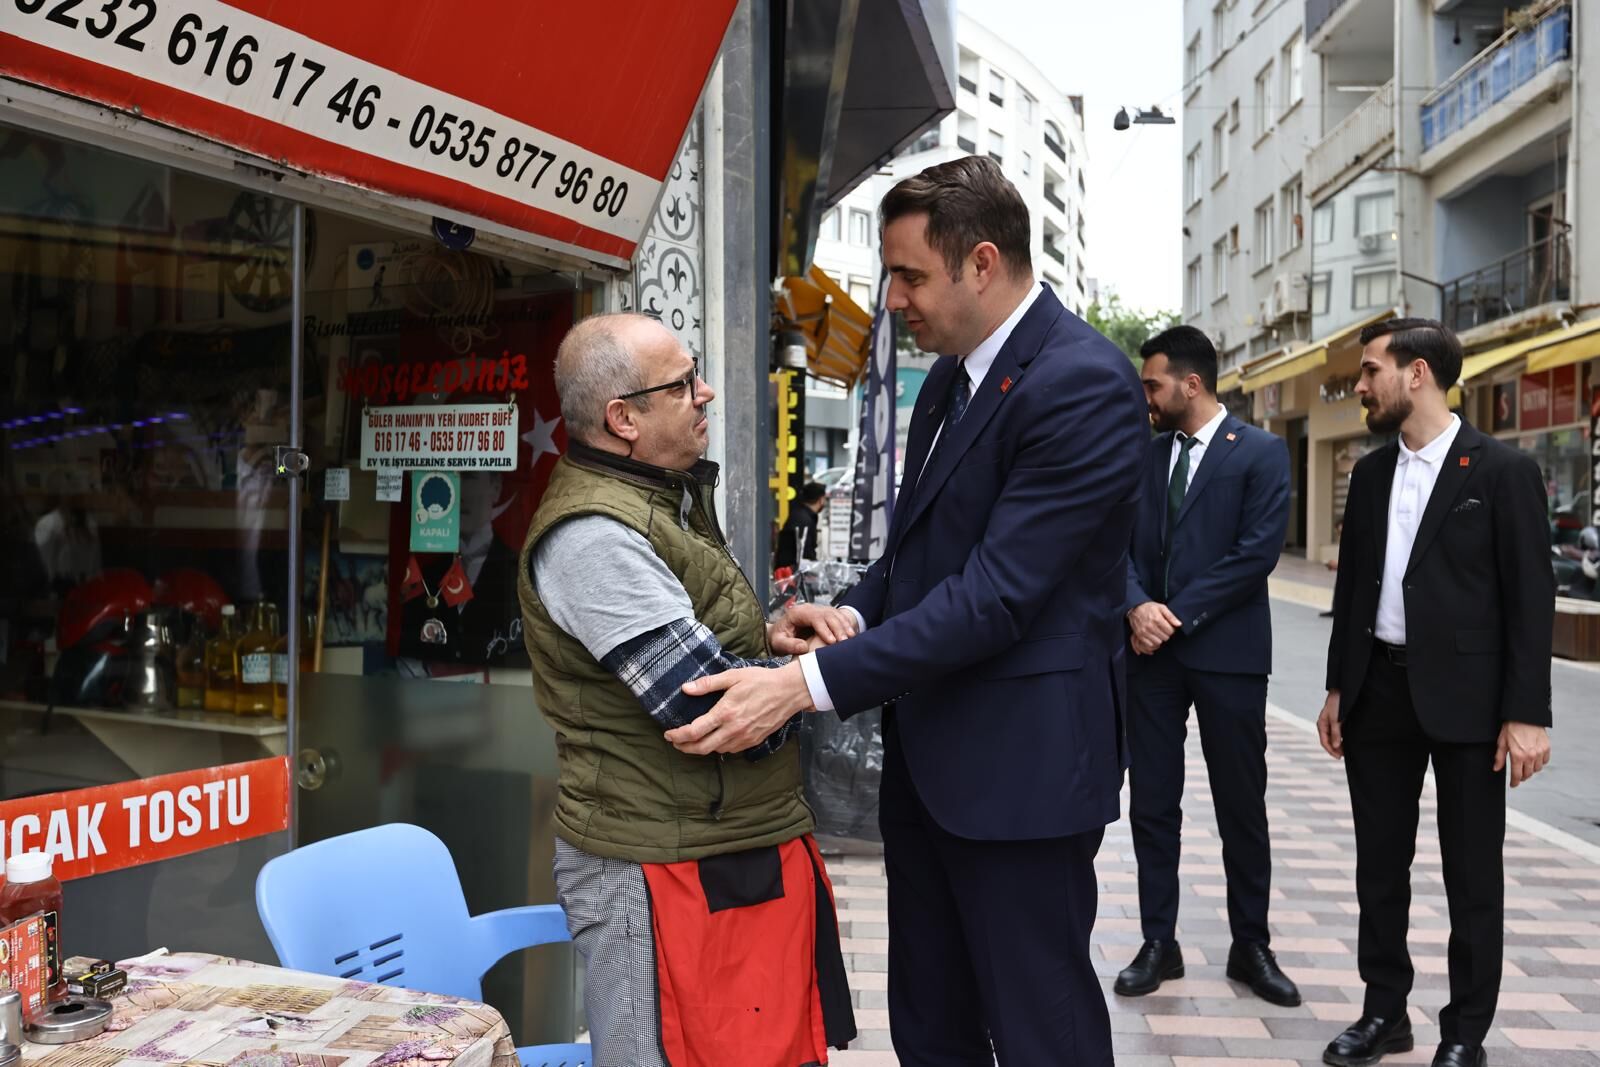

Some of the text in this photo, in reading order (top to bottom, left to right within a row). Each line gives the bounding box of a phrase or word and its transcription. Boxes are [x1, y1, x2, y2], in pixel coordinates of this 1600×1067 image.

[15, 0, 156, 52] 232
[168, 13, 259, 86] 616
[273, 52, 326, 107] 17
[327, 78, 381, 131] 46
[409, 105, 496, 168] 0535
[496, 137, 557, 189] 877
[555, 161, 593, 204] 96
[592, 176, 628, 217] 80
[368, 410, 393, 428] GÜLER
[395, 412, 435, 428] HANIM'IN
[437, 409, 456, 427] YERİ
[458, 412, 490, 427] KUDRET
[375, 431, 392, 452] 616
[395, 431, 406, 452] 17
[409, 431, 421, 452] 46
[431, 431, 454, 452] 0535
[457, 430, 475, 452] 877
[478, 430, 490, 452] 96
[493, 430, 505, 451] 80
[367, 456, 512, 469] EV VE İŞYERLERİNE SERVİS YAPILIR
[419, 527, 450, 537] KAPALI
[123, 775, 250, 848] TOSTU
